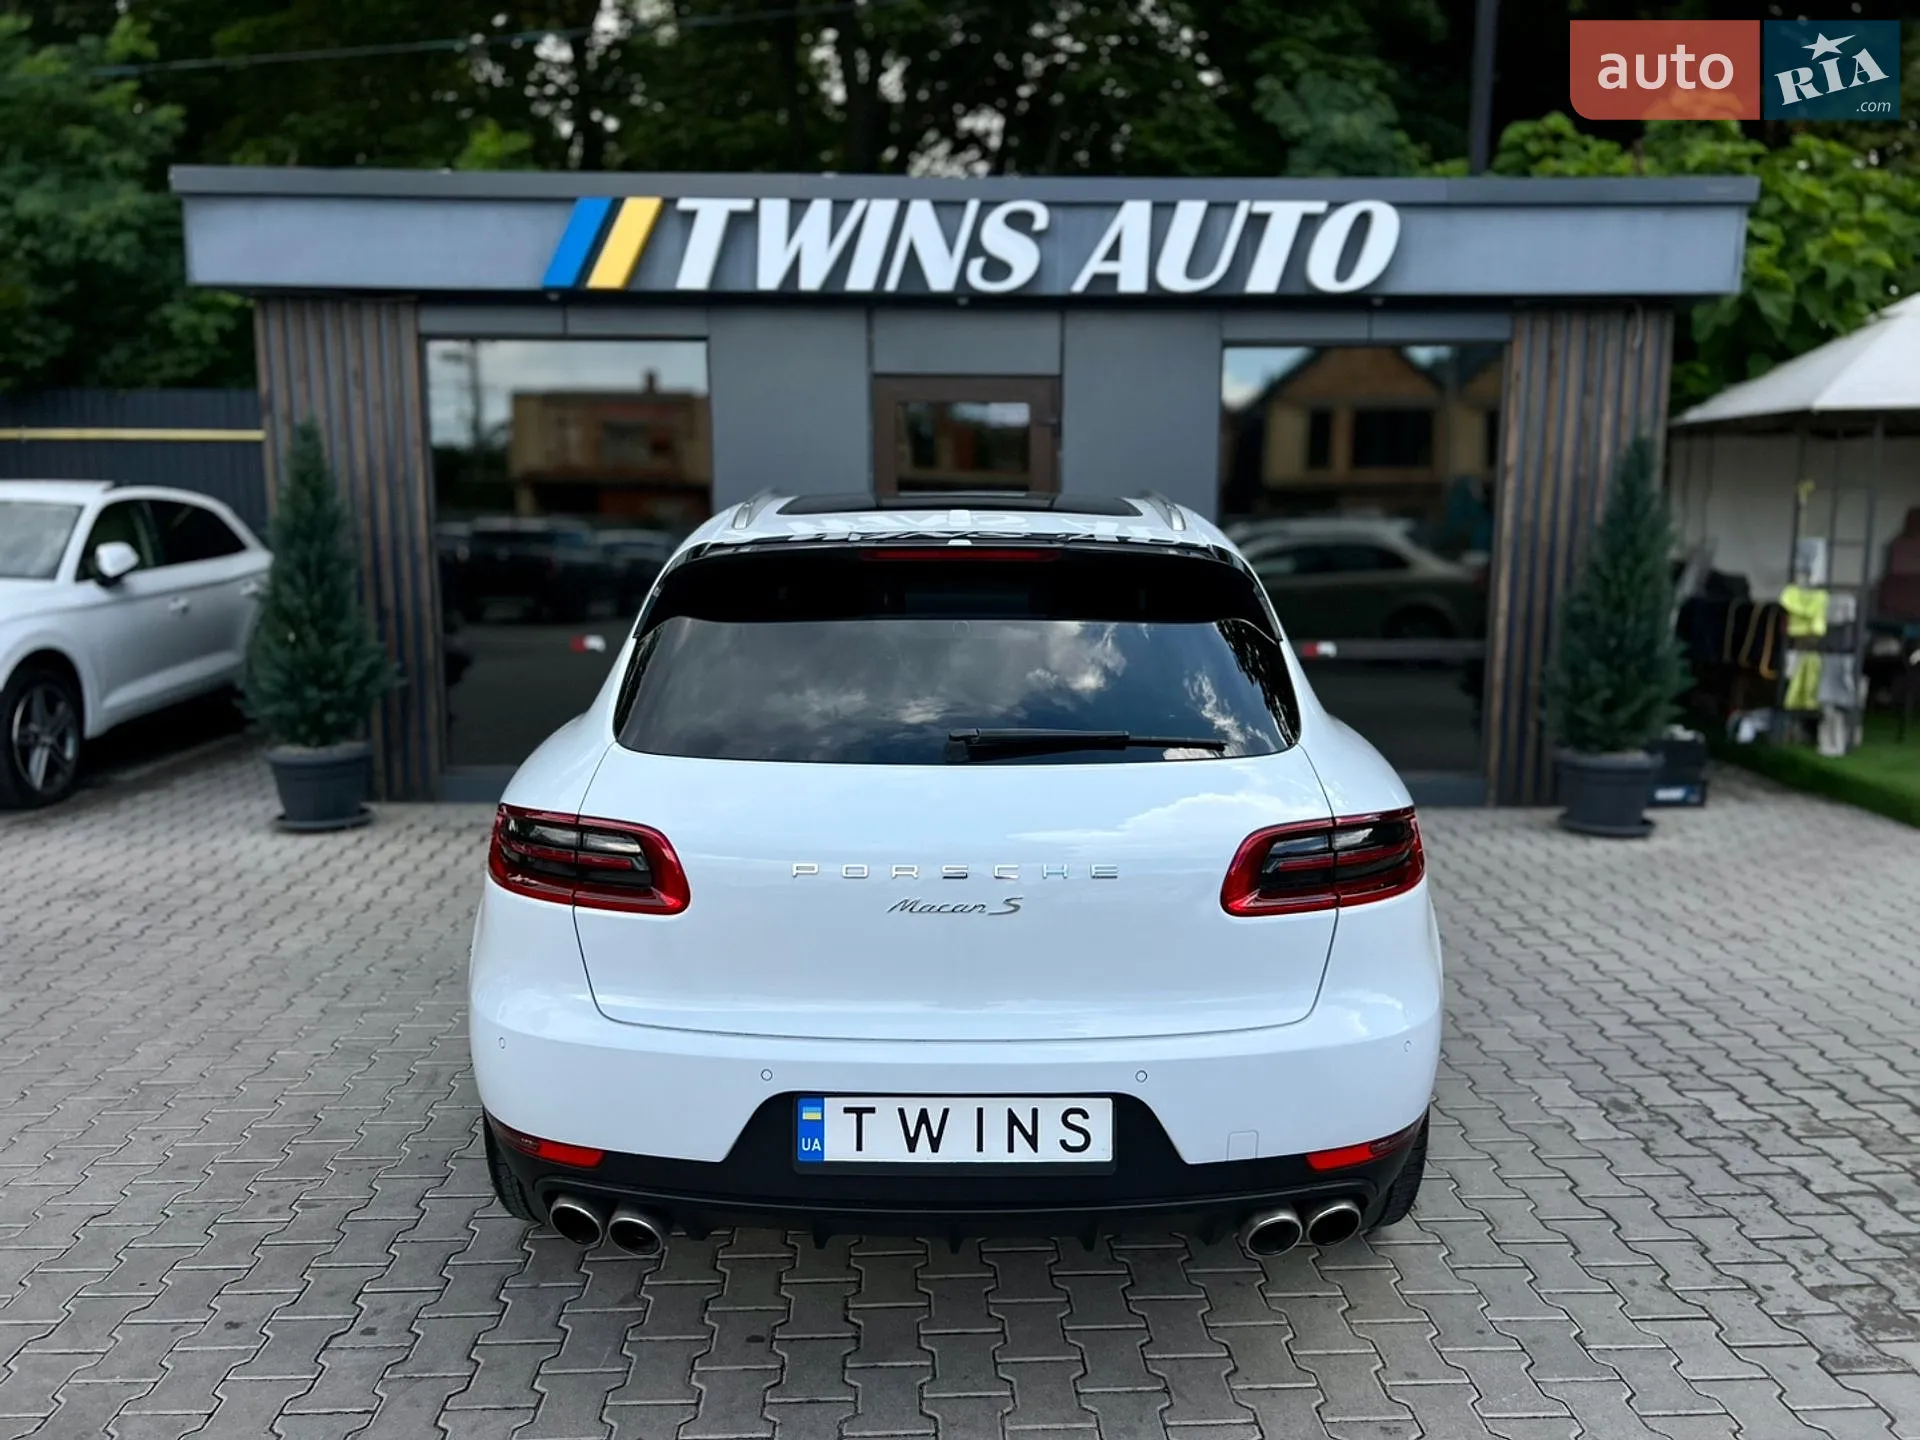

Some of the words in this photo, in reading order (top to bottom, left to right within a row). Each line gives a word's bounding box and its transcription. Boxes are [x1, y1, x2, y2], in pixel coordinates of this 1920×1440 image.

[674, 197, 1049, 294] TWINS
[1071, 199, 1401, 295] AUTO
[792, 862, 1119, 880] PORSCHE
[887, 897, 987, 914] Macan
[987, 896, 1025, 916] S
[801, 1137, 822, 1152] UA
[842, 1106, 1092, 1154] TWINS
